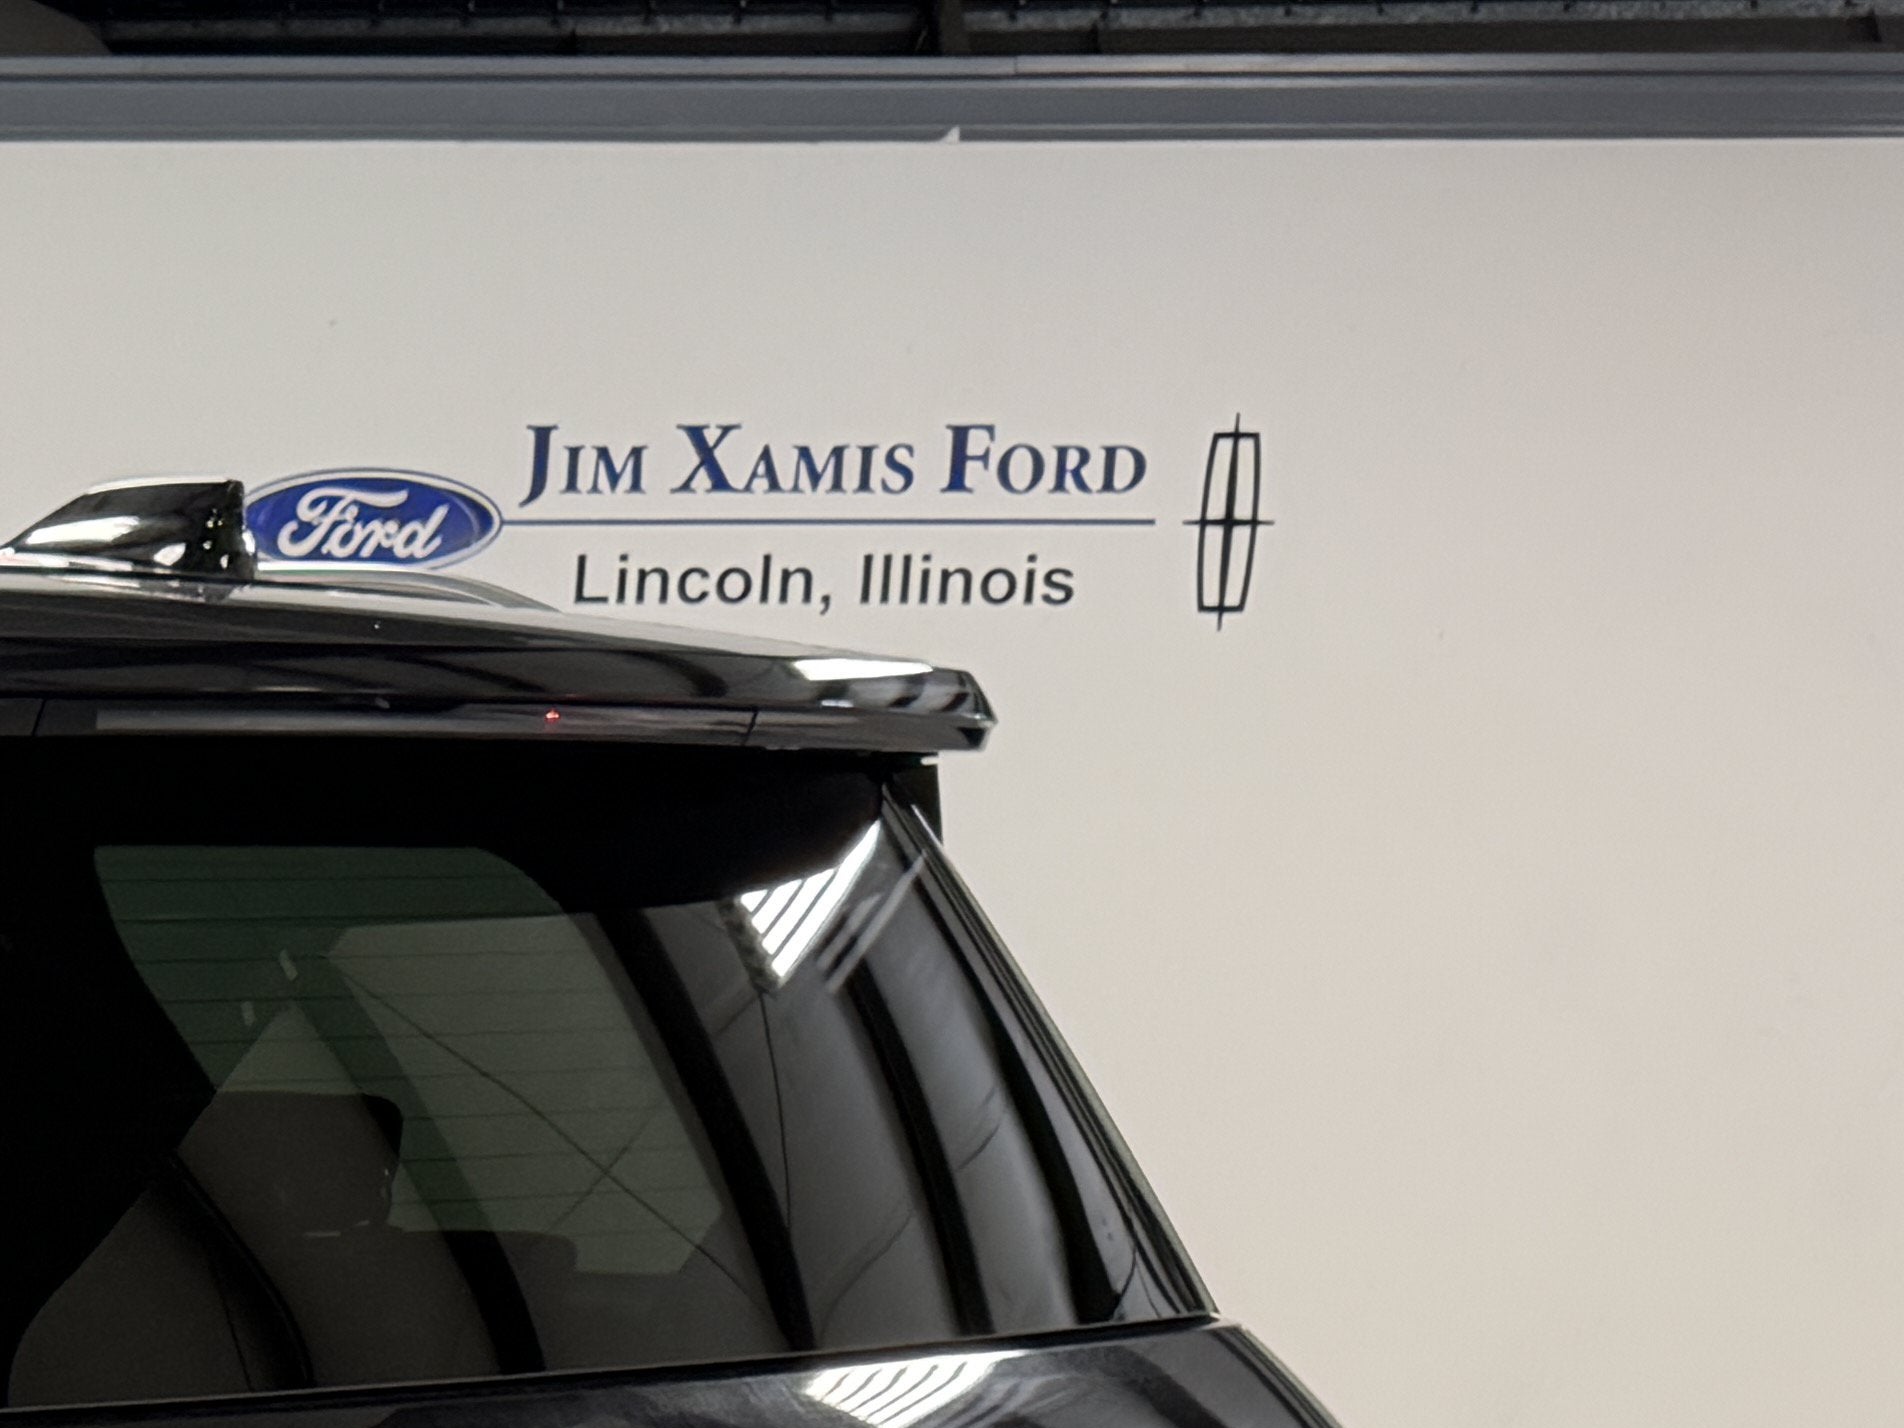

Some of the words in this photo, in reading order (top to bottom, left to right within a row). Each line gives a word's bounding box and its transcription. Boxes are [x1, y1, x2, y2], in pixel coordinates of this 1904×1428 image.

[519, 424, 648, 508] JIM
[670, 424, 914, 495] XAMIS
[940, 424, 1147, 495] FORD
[277, 487, 450, 559] Ford
[574, 553, 831, 615] Lincoln,
[860, 553, 1074, 606] Illinois
